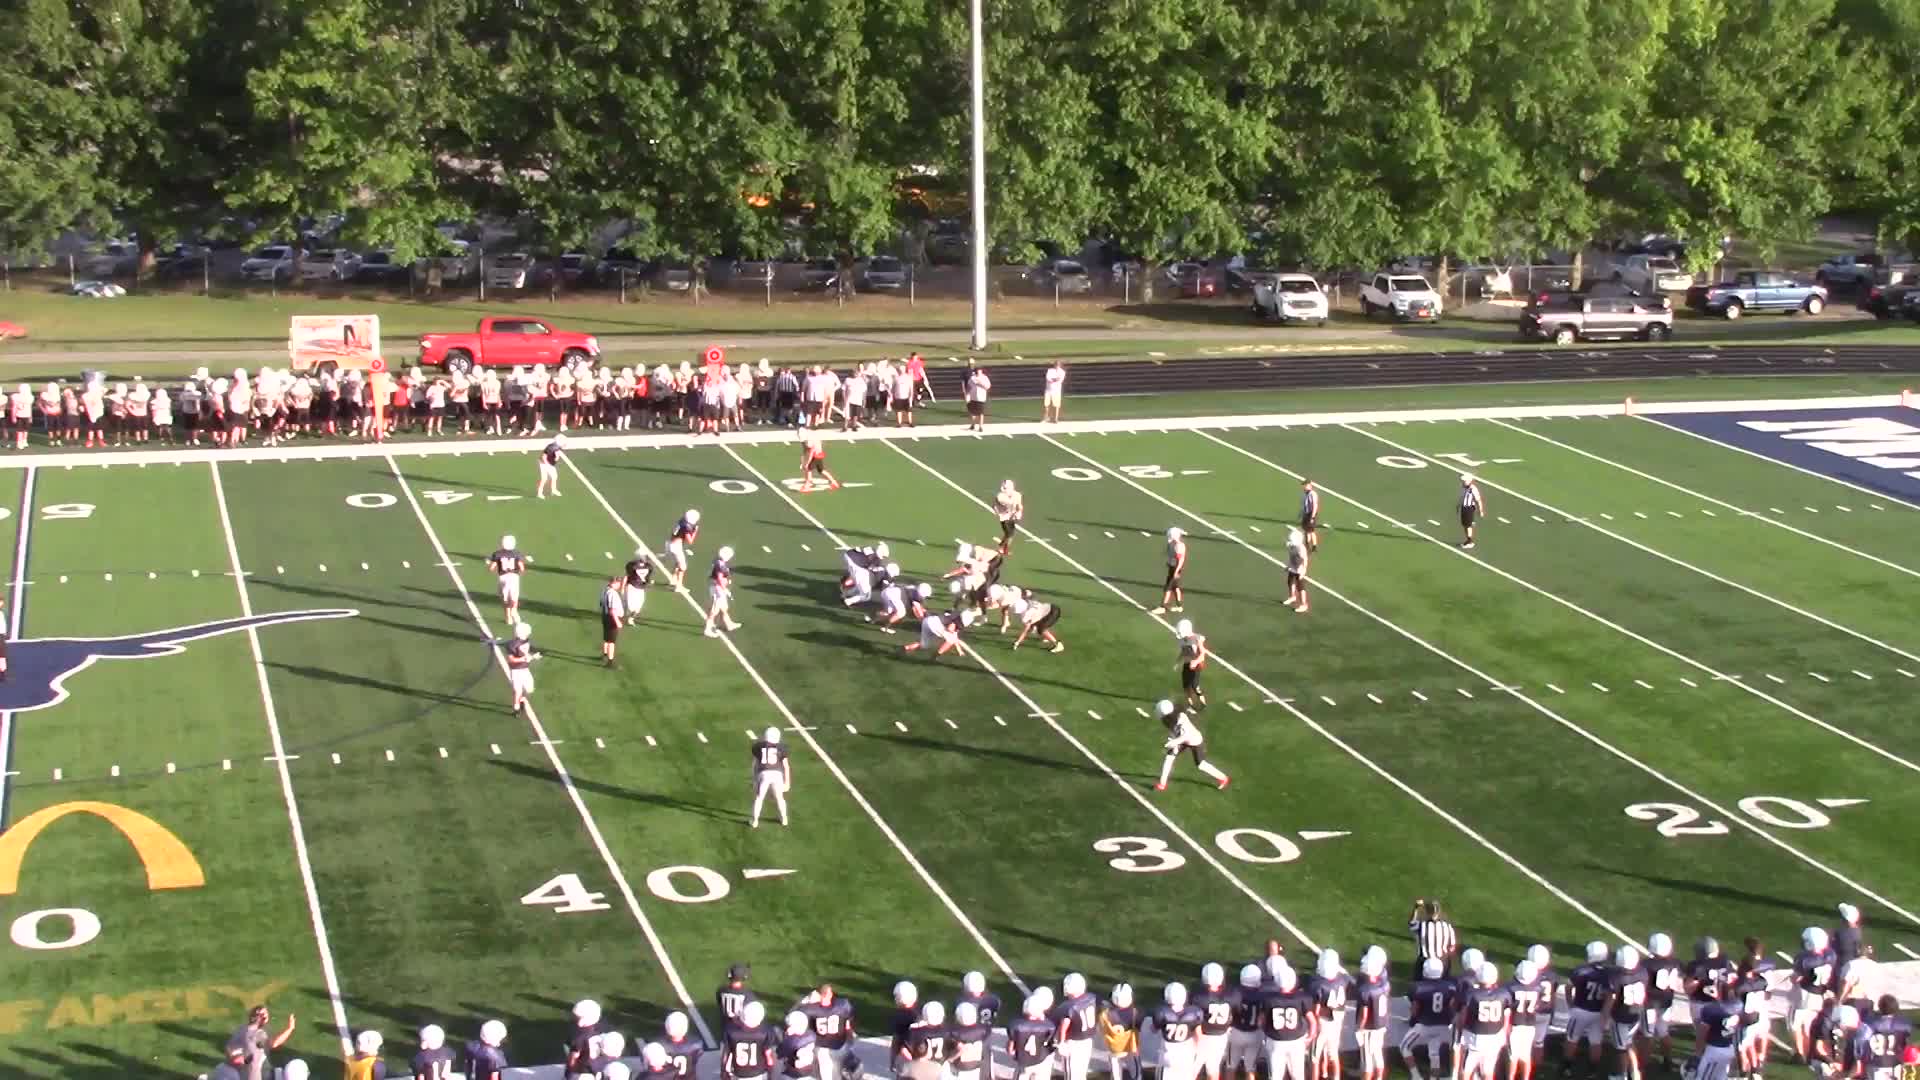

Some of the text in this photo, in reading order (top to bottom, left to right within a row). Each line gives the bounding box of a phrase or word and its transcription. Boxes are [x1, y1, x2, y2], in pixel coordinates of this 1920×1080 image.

[1624, 796, 1831, 837] 20
[1093, 828, 1301, 872] 30
[521, 866, 731, 913] 40
[10, 907, 101, 949] 0
[1514, 990, 1538, 1013] 77
